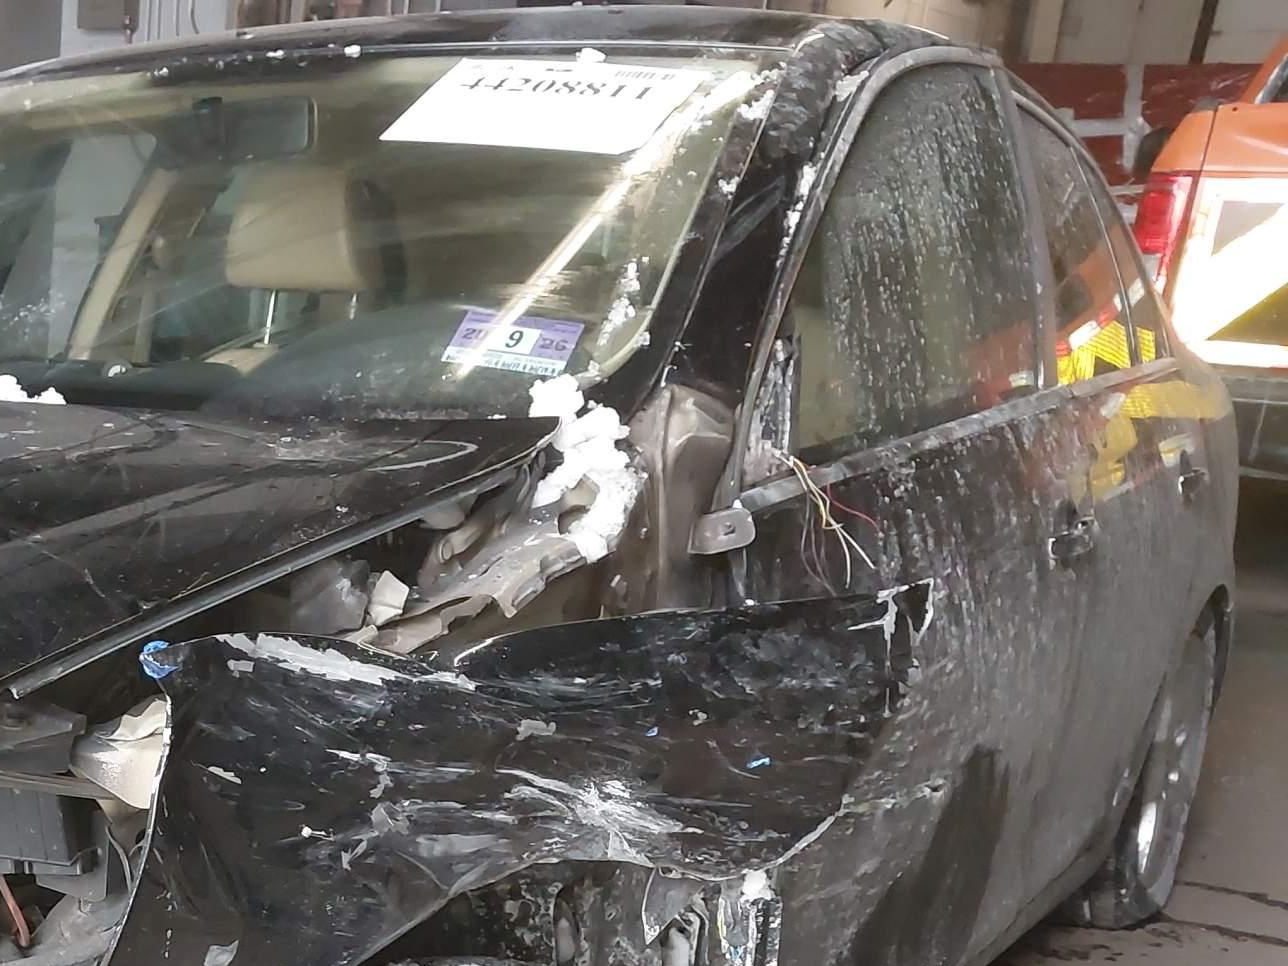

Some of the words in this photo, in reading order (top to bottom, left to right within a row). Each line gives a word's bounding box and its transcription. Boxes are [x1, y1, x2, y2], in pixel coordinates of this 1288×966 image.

[460, 76, 653, 100] 44208811
[504, 330, 524, 349] 9
[538, 336, 569, 352] 26
